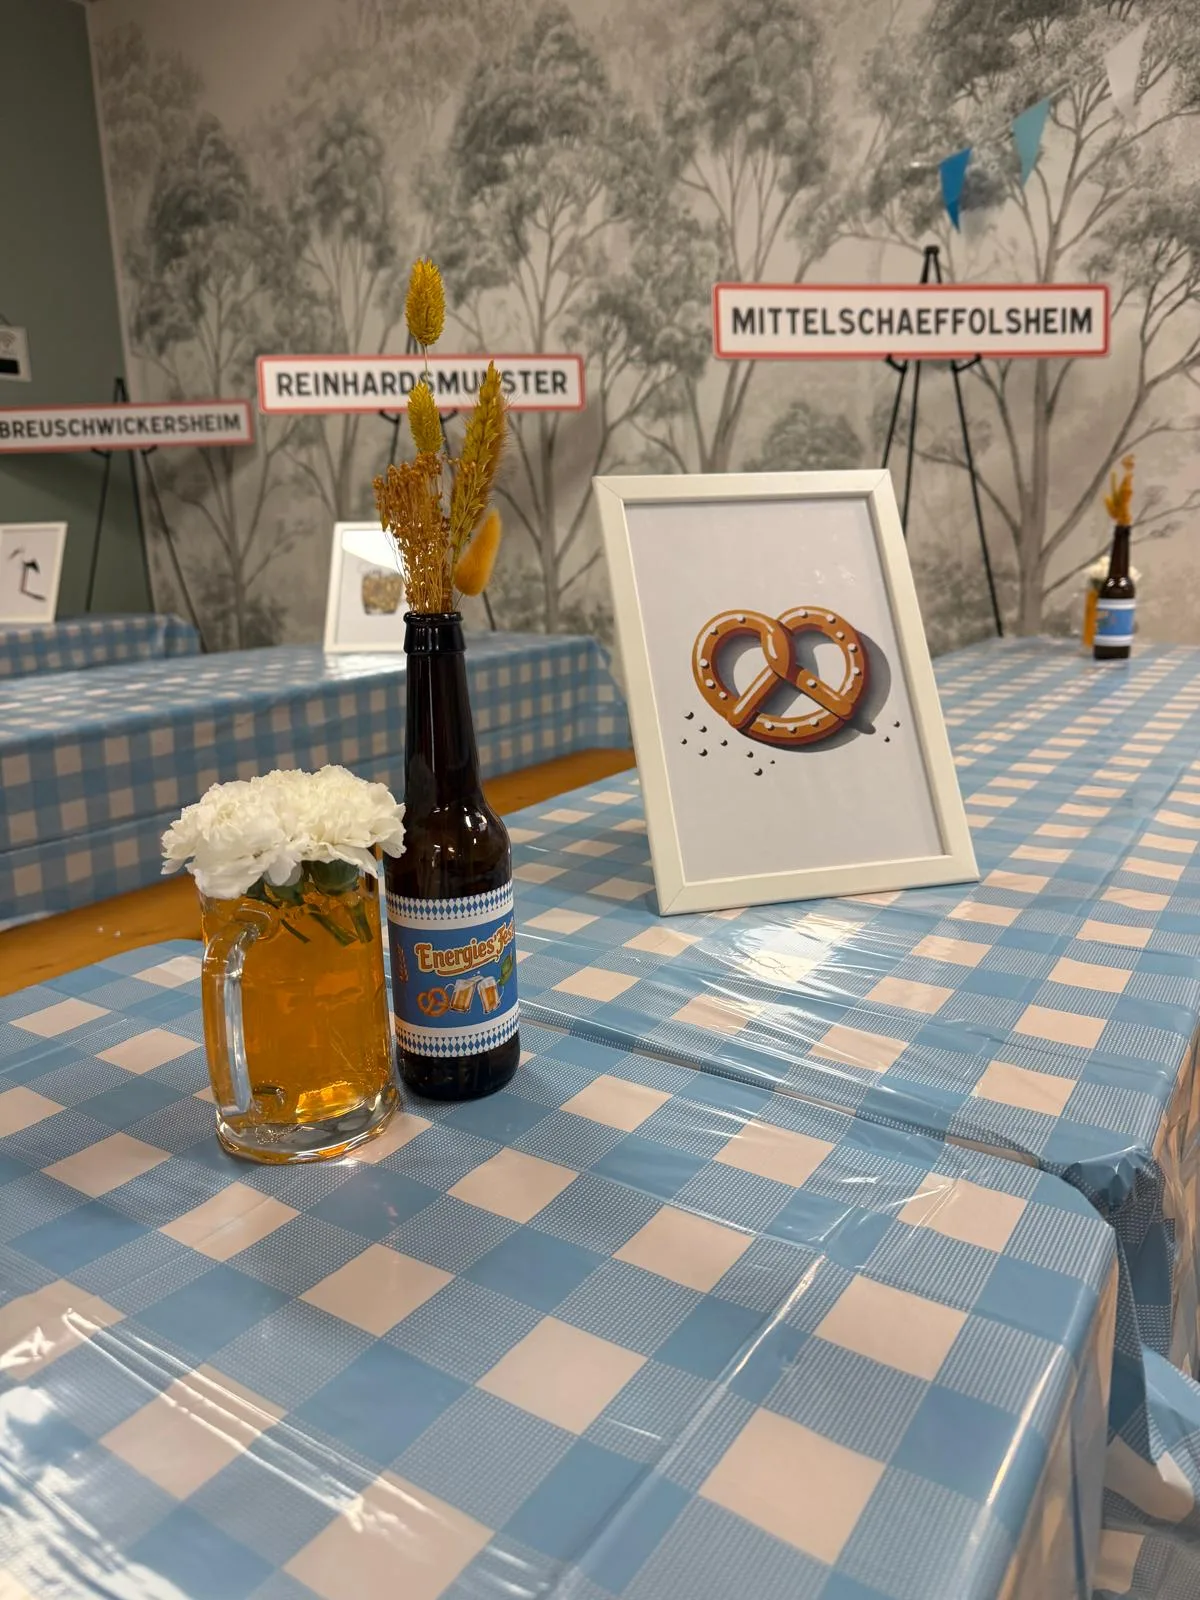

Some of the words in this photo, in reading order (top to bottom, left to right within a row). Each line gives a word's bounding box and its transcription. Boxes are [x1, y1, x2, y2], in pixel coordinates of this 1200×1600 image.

[731, 306, 1093, 336] MITTELSCHAEFFOLSHEIM
[276, 370, 568, 397] REINHARDSMUSTER
[0, 413, 242, 439] BREUSCHWICKERSHEIM
